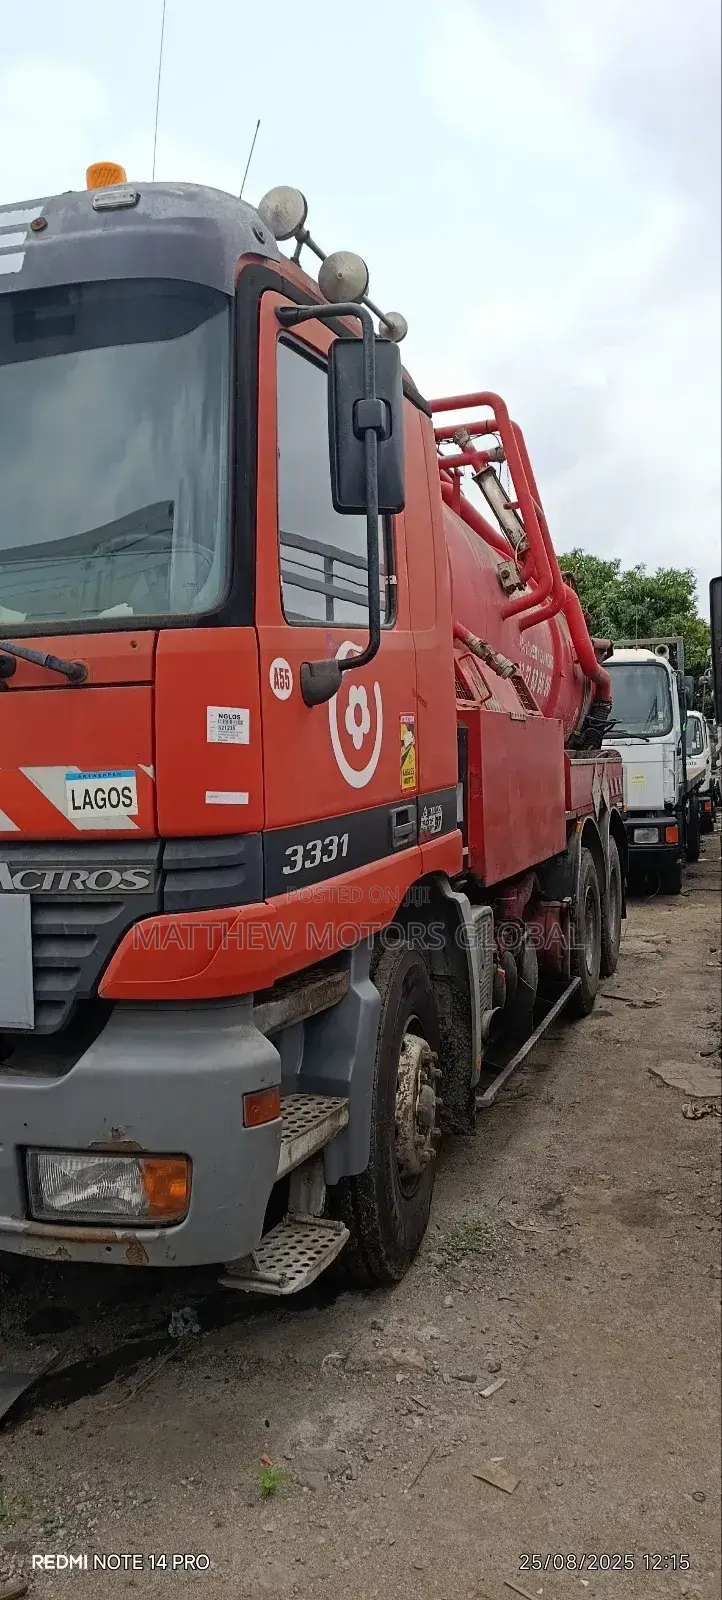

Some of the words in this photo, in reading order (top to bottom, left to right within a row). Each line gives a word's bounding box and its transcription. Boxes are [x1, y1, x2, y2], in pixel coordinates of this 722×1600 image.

[273, 666, 290, 690] A55
[71, 786, 133, 810] LAGOS
[282, 832, 349, 875] 3331
